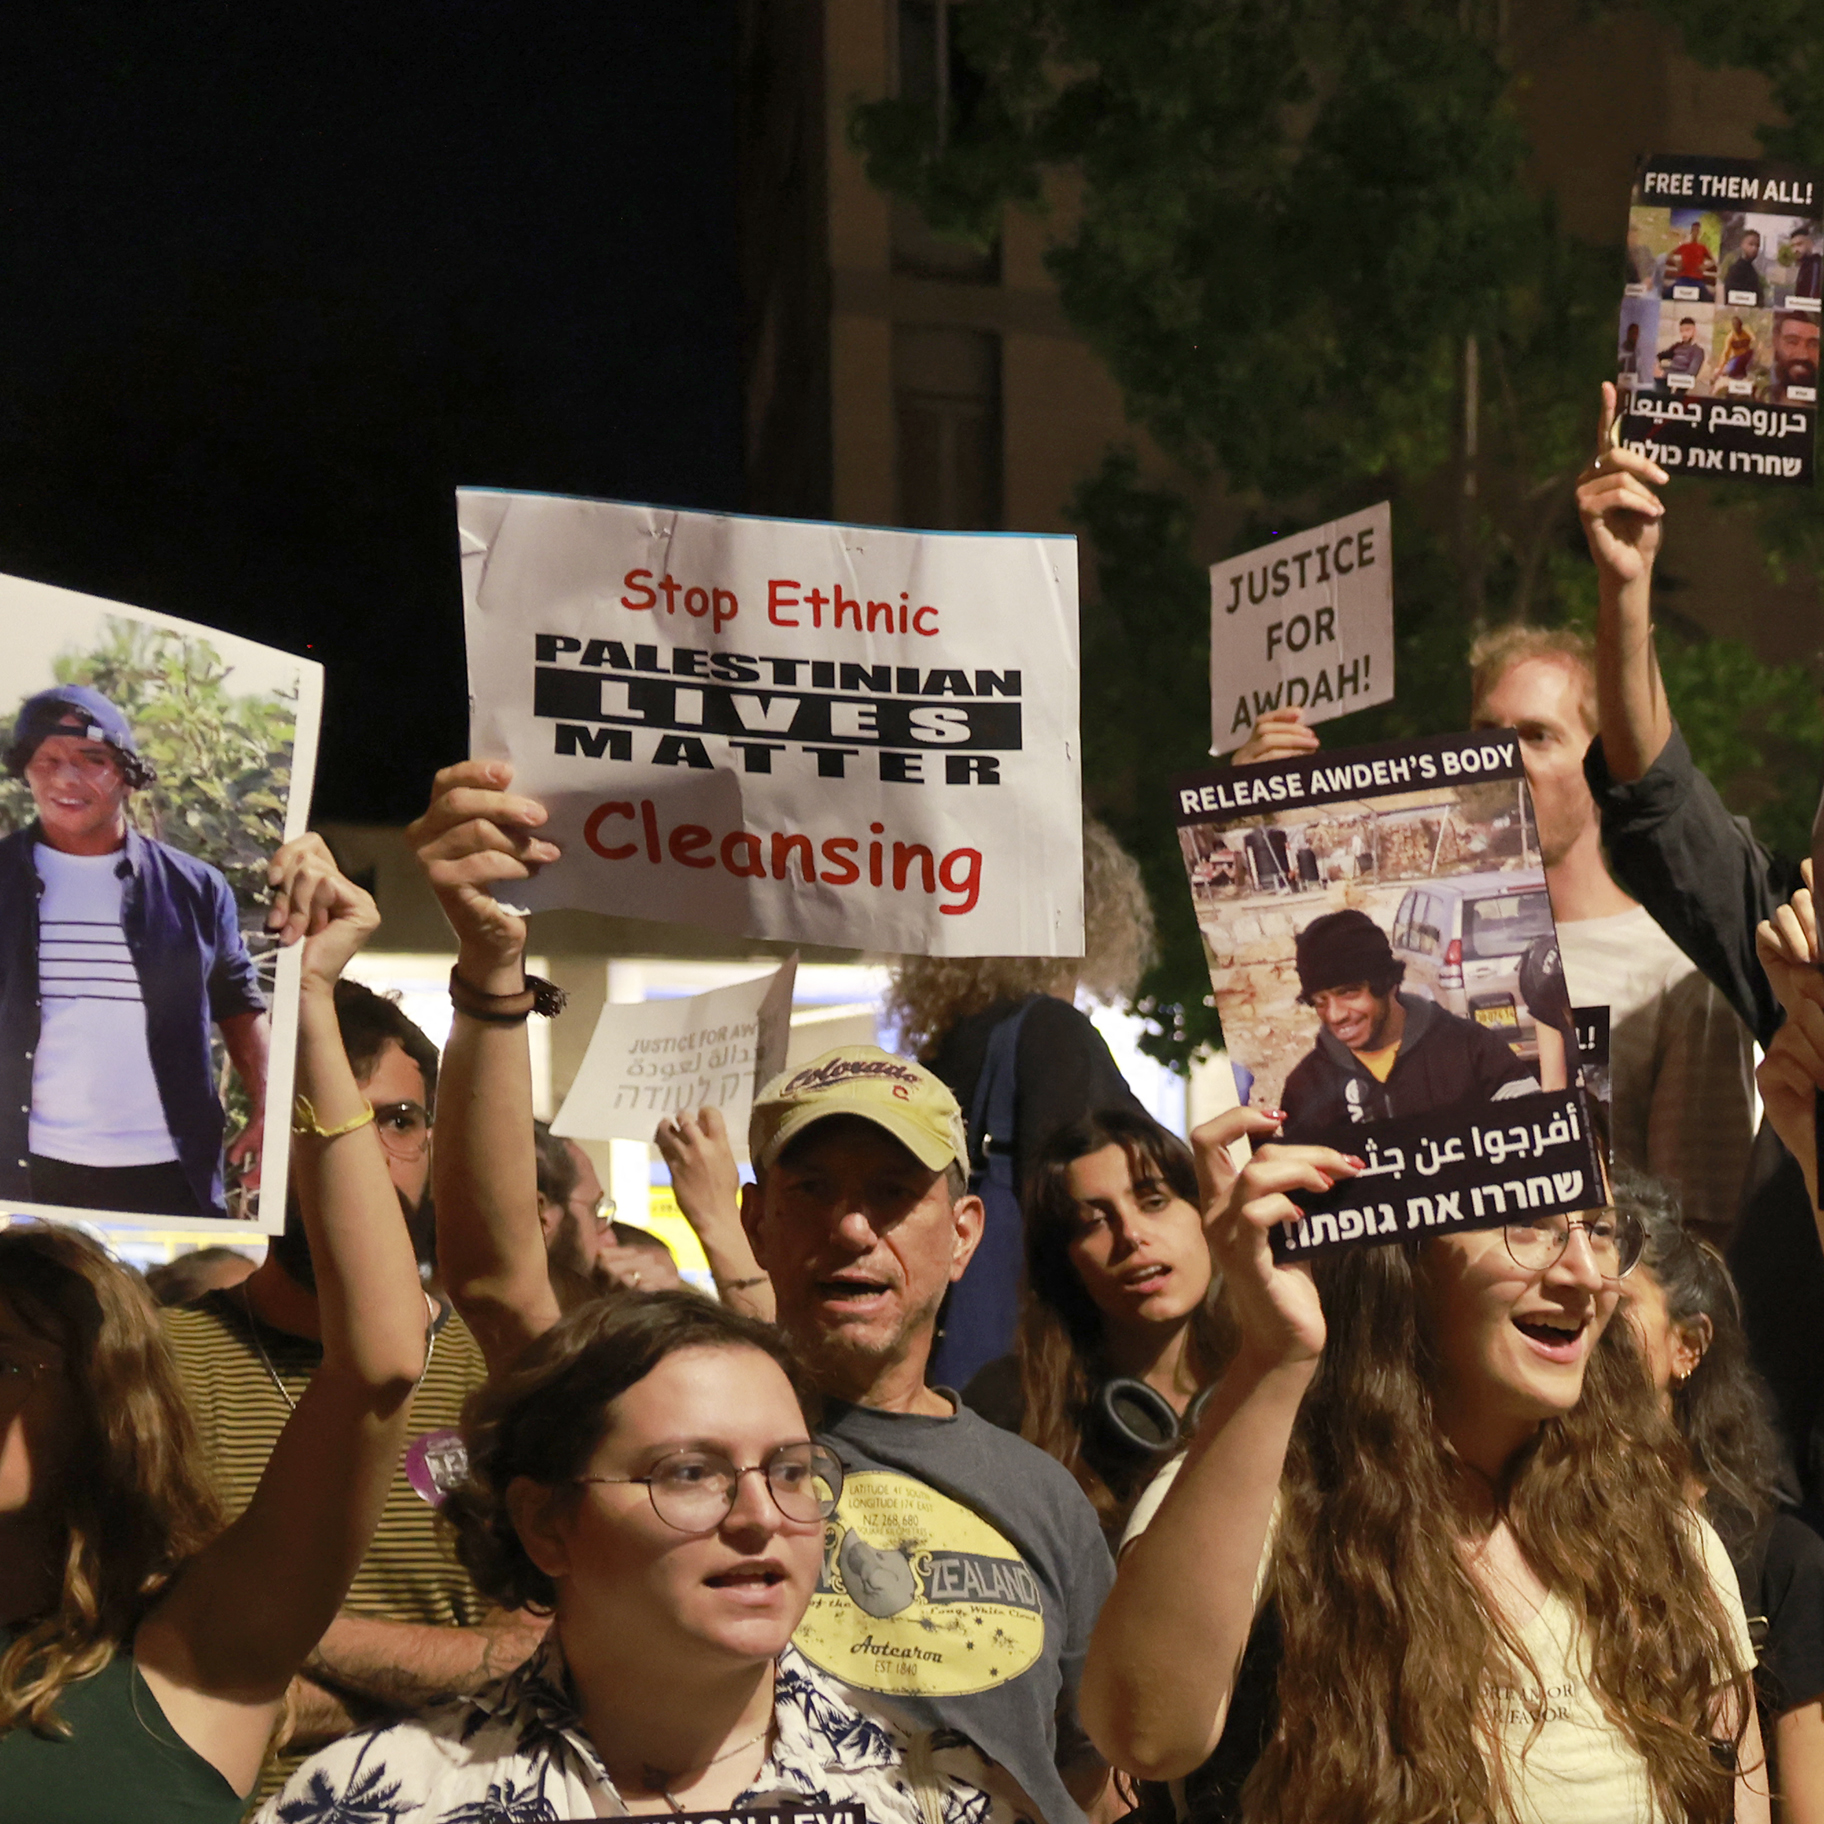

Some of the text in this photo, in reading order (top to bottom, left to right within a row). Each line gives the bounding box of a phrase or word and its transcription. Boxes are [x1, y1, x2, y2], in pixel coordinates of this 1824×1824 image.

[1644, 172, 1813, 205] FREE THEM ALL!
[1708, 405, 1807, 438] حرروهم
[1686, 444, 1724, 471] את
[1729, 451, 1802, 478] שחררו
[1225, 527, 1376, 615] JUSTICE
[620, 568, 940, 637] Stop Ethnic
[1266, 606, 1336, 662] FOR
[534, 633, 1023, 698] PALESTINIAN
[600, 679, 973, 745] LIVES
[1230, 654, 1371, 735] AWDAH!
[554, 722, 1001, 786] MATTER
[1179, 772, 1305, 815] RELEASE
[1441, 742, 1517, 778] BODY
[583, 799, 984, 916] Cleansing
[628, 1032, 696, 1055] JUSTICE
[699, 1025, 728, 1047] FOR
[1414, 1136, 1466, 1177] عن
[1470, 1101, 1582, 1165] أفرجوا
[1281, 1169, 1585, 1251] שחררו את גופתו!
[848, 1497, 899, 1510] LONGITUDE
[849, 1483, 890, 1496] LATITUDE
[862, 1514, 879, 1527] NZ
[930, 1557, 1037, 1606] ZEALAND
[895, 1660, 918, 1676] 1840
